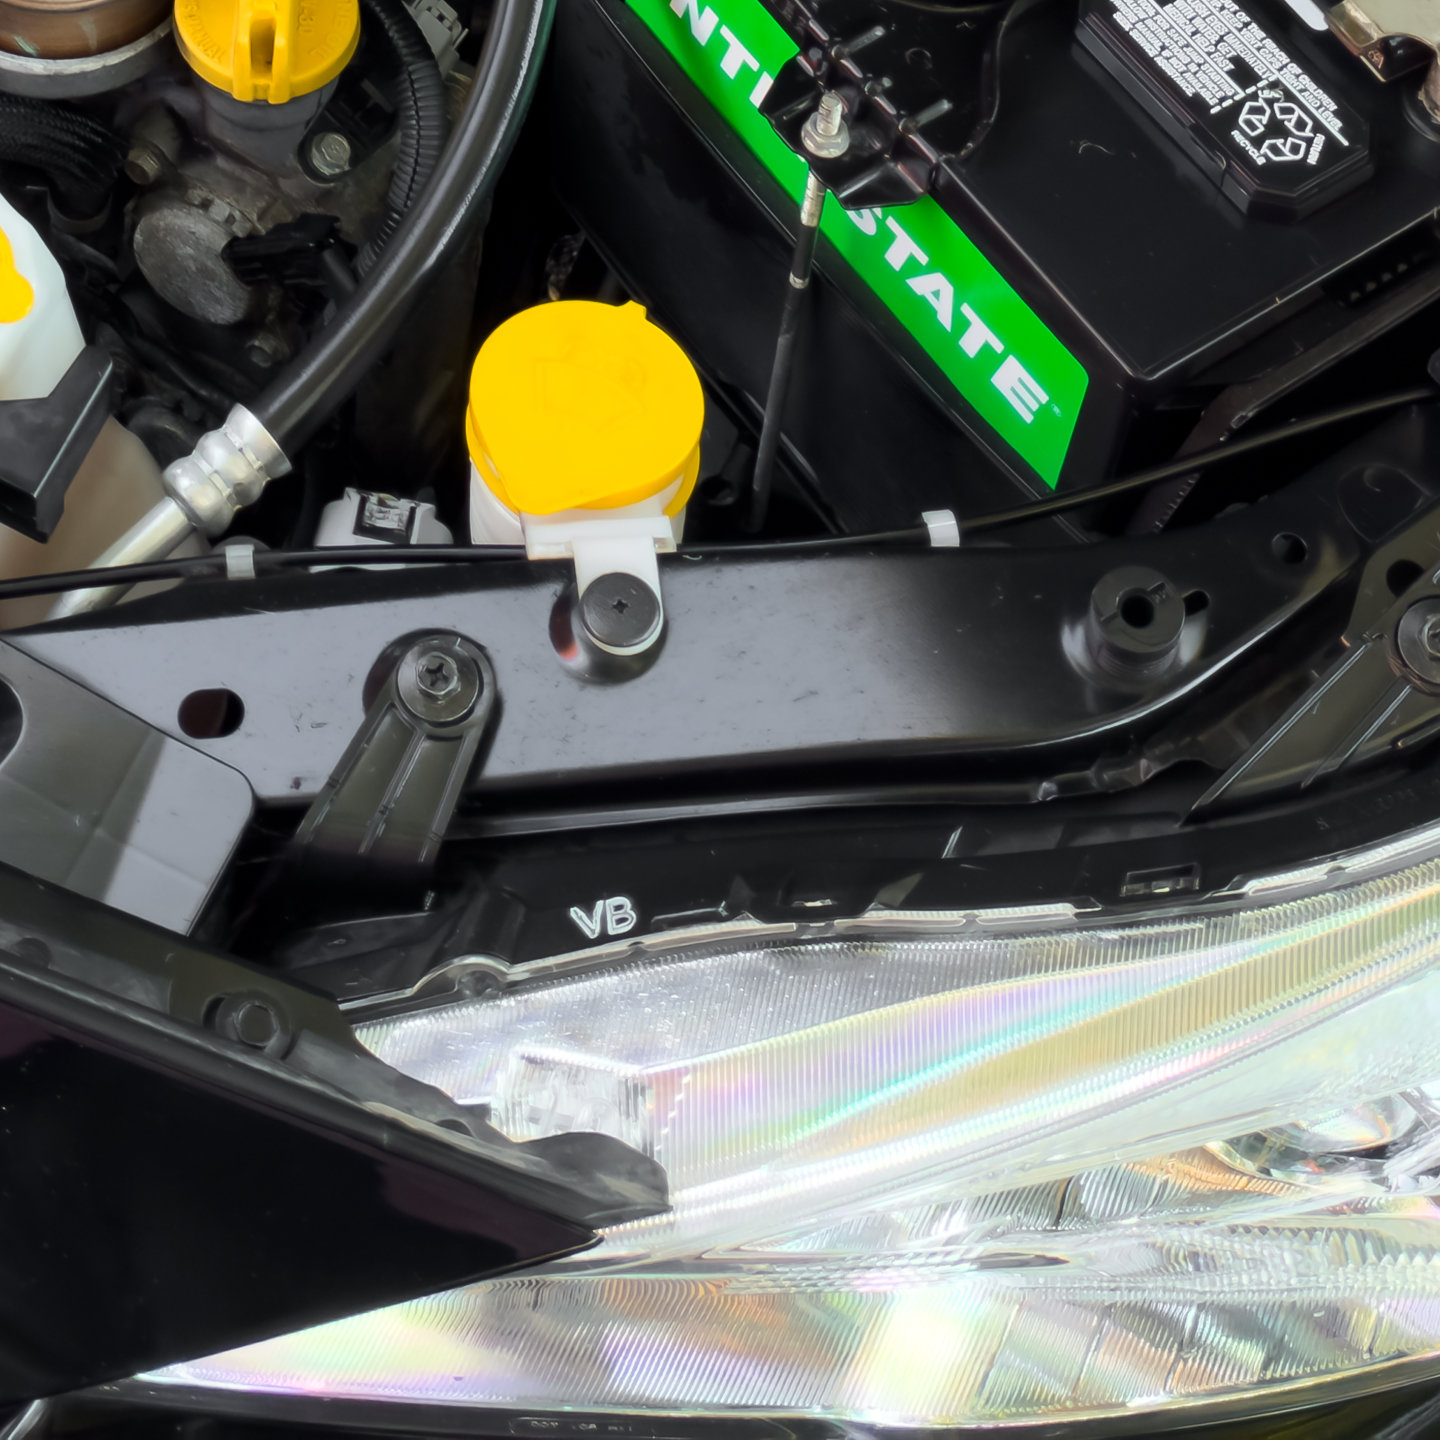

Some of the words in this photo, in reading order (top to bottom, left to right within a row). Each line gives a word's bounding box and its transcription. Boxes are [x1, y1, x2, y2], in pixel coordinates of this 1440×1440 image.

[1160, 3, 1201, 37] MEDICAL
[1189, 33, 1218, 55] HELP
[1203, 14, 1231, 36] EYES
[1231, 10, 1253, 25] OF
[1244, 22, 1267, 40] THE
[1283, 61, 1304, 77] OF
[1214, 41, 1238, 59] GET
[1217, 8, 1244, 30] KEEP
[1237, 27, 1264, 49] VENT
[1276, 67, 1307, 93] TIGHT
[1298, 89, 1323, 109] AND
[569, 896, 637, 939] VB
